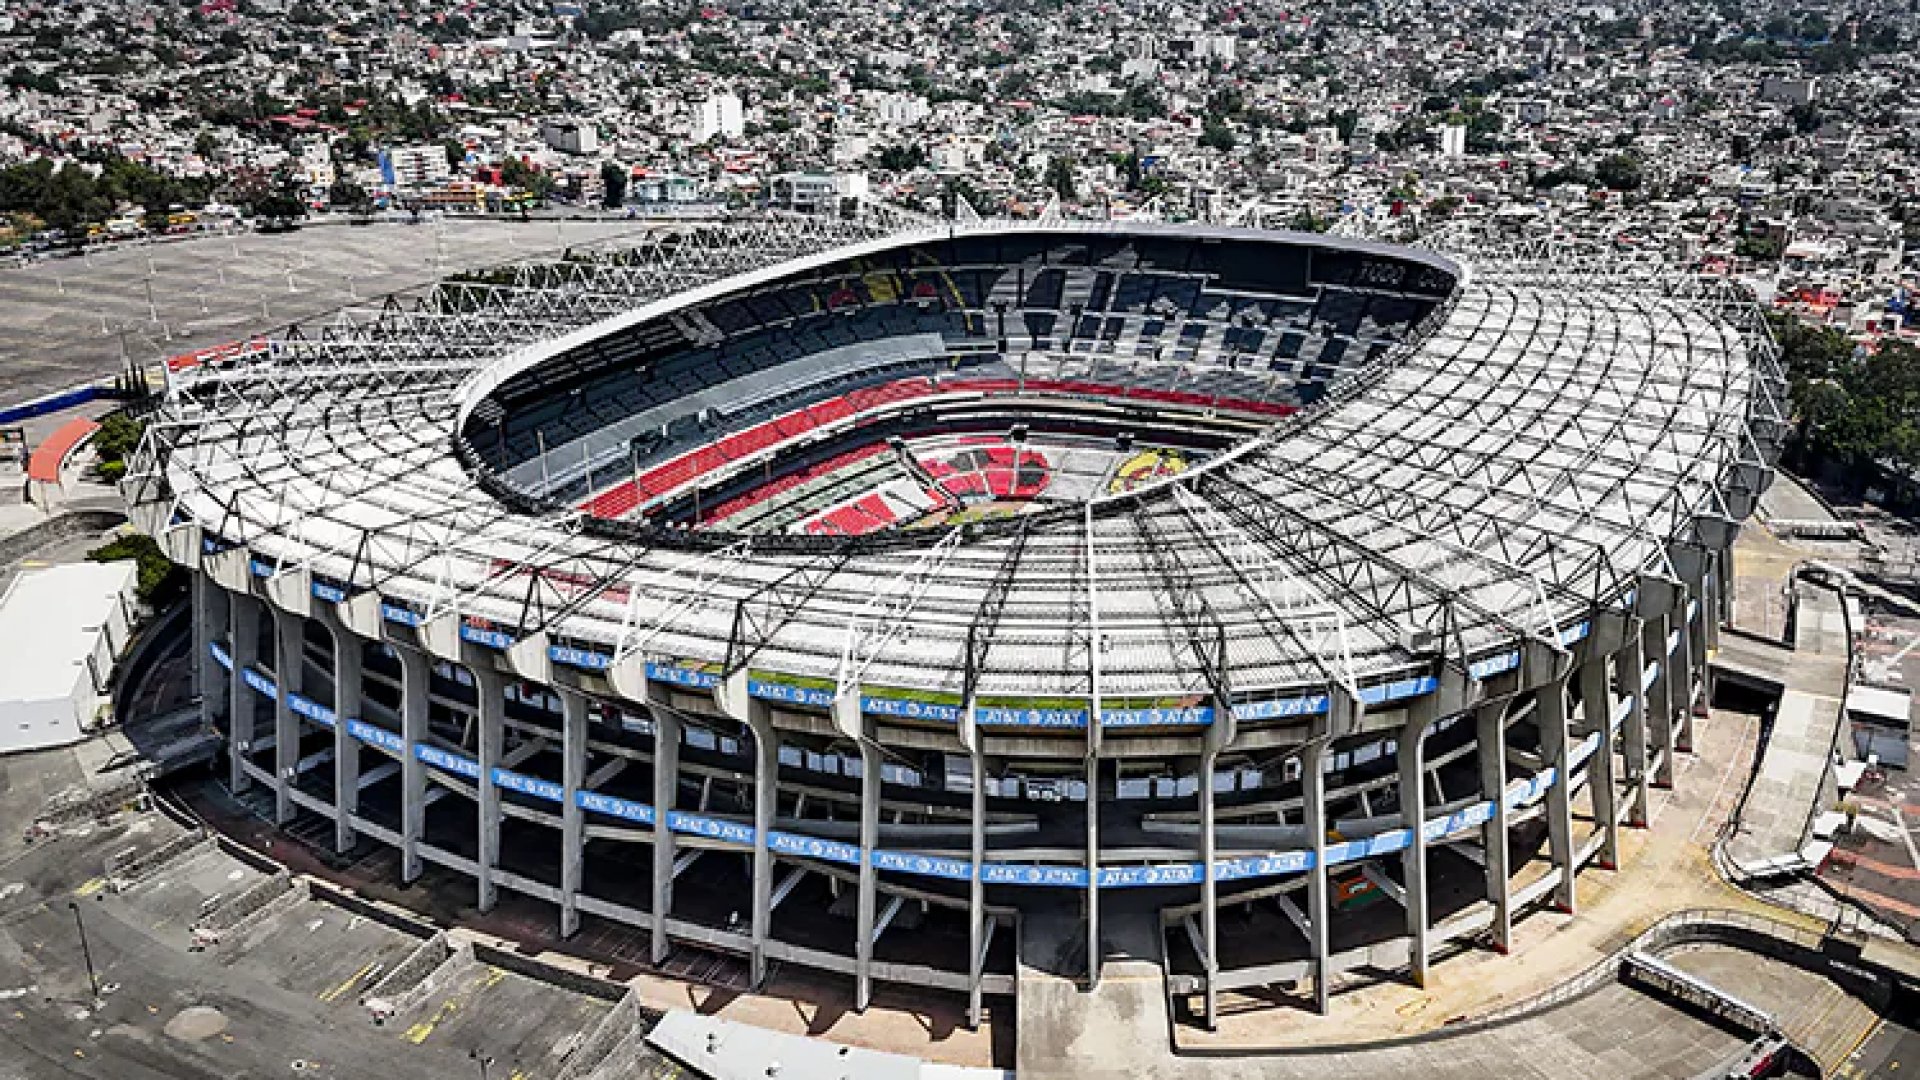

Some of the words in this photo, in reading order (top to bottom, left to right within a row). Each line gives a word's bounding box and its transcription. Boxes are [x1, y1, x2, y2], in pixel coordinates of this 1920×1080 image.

[867, 699, 900, 713] AT&T
[922, 705, 957, 720] AT&T
[985, 710, 1020, 724] AT&T
[1040, 711, 1080, 725] AT&T
[1104, 710, 1141, 724] AT&T
[1164, 709, 1203, 723] AT&T
[775, 836, 806, 850] AT&T
[824, 844, 853, 859] AT&T
[880, 854, 913, 869] AT&T
[931, 861, 965, 876] AT&T
[989, 866, 1022, 881] AT&T
[1044, 868, 1078, 883] AT&T
[1104, 870, 1140, 884] AT&T
[1158, 868, 1194, 882] AT&T
